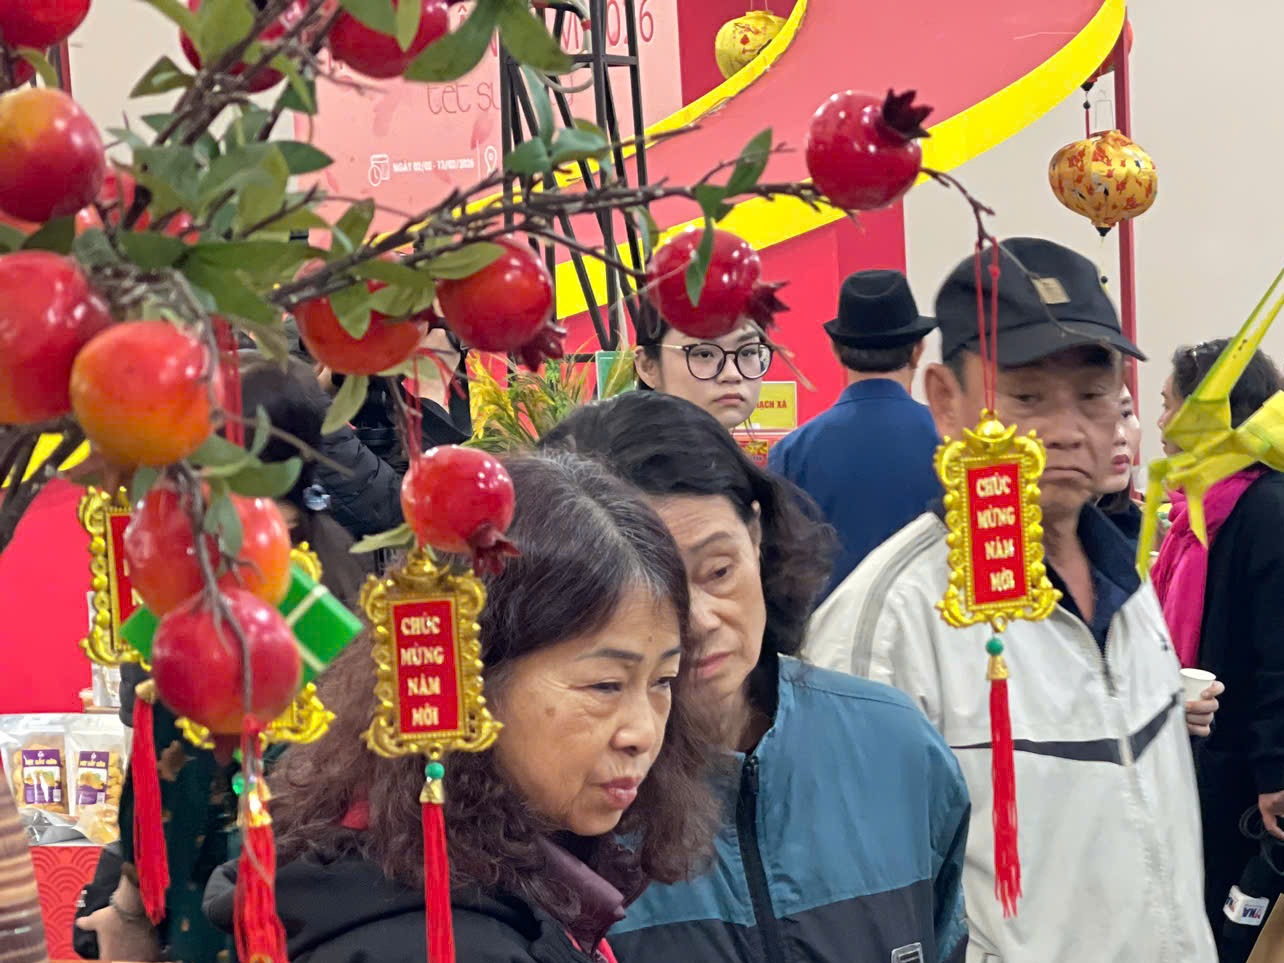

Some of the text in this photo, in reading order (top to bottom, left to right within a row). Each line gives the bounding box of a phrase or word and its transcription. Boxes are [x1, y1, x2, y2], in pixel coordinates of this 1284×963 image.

[975, 472, 1012, 497] CHÚC
[976, 504, 1016, 529] MỪNG
[984, 536, 1015, 560] NĂM
[989, 567, 1016, 592] MỚI
[400, 611, 441, 636] CHÚC
[400, 641, 445, 666] MỪNG
[407, 673, 441, 696] NĂM
[411, 702, 440, 727] MỚI
